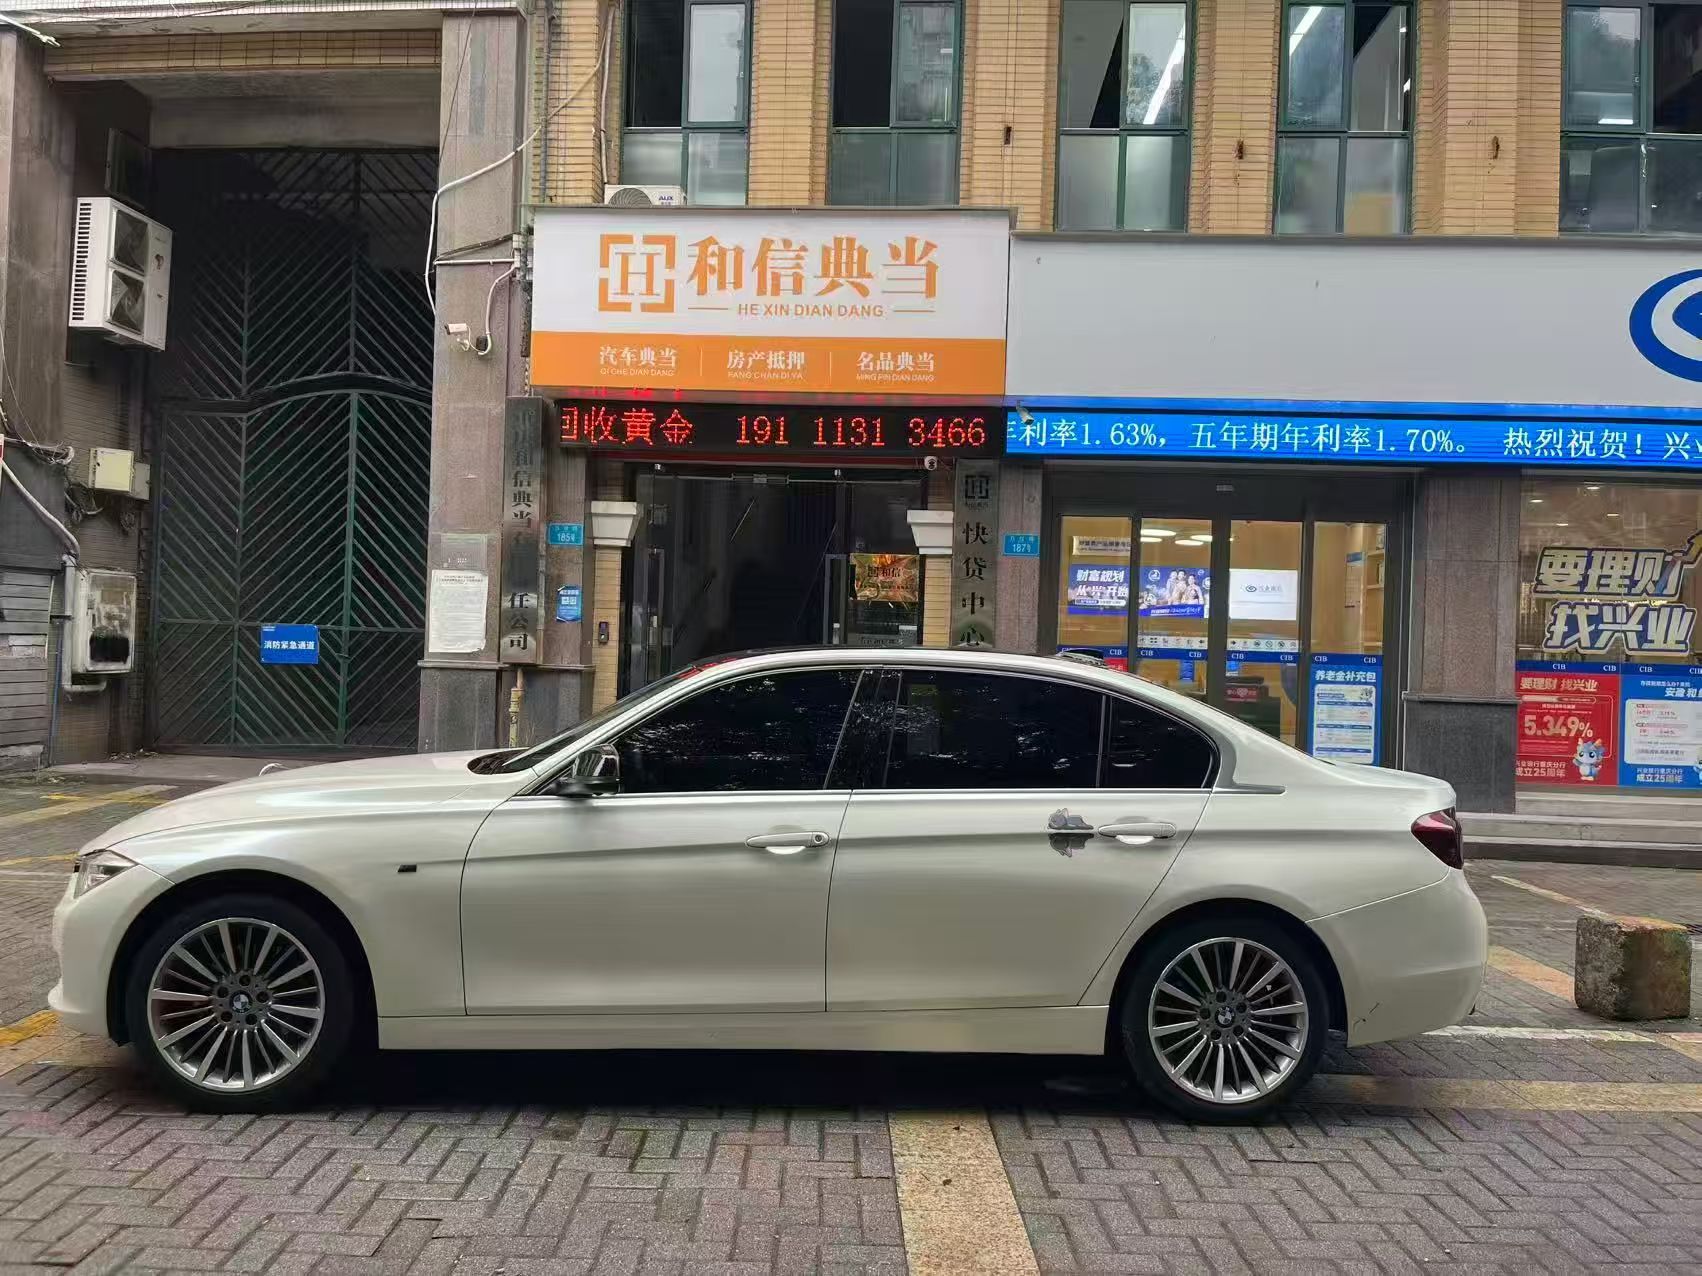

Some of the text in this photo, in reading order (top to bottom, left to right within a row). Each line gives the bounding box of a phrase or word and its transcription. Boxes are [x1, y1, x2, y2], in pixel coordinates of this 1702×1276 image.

[686, 235, 939, 299] 和信典当
[738, 303, 884, 318] HE XIN DIAN DANG
[600, 346, 677, 368] 汽车典当
[727, 349, 805, 370] 房产抵押
[857, 351, 935, 372] 名品典当
[736, 415, 790, 444] 191
[813, 417, 885, 446] 1131
[908, 417, 986, 448] 3466
[1077, 569, 1125, 583] 财富规划
[1537, 549, 1682, 596] 要理财
[960, 522, 988, 647] 快贷中心
[1547, 604, 1694, 650] 找兴业
[263, 640, 316, 650] 消防紧急通道
[1315, 670, 1377, 683] 养老金补充包
[1520, 677, 1598, 692] 要理财 找兴业
[1524, 714, 1594, 738] 5.349%
